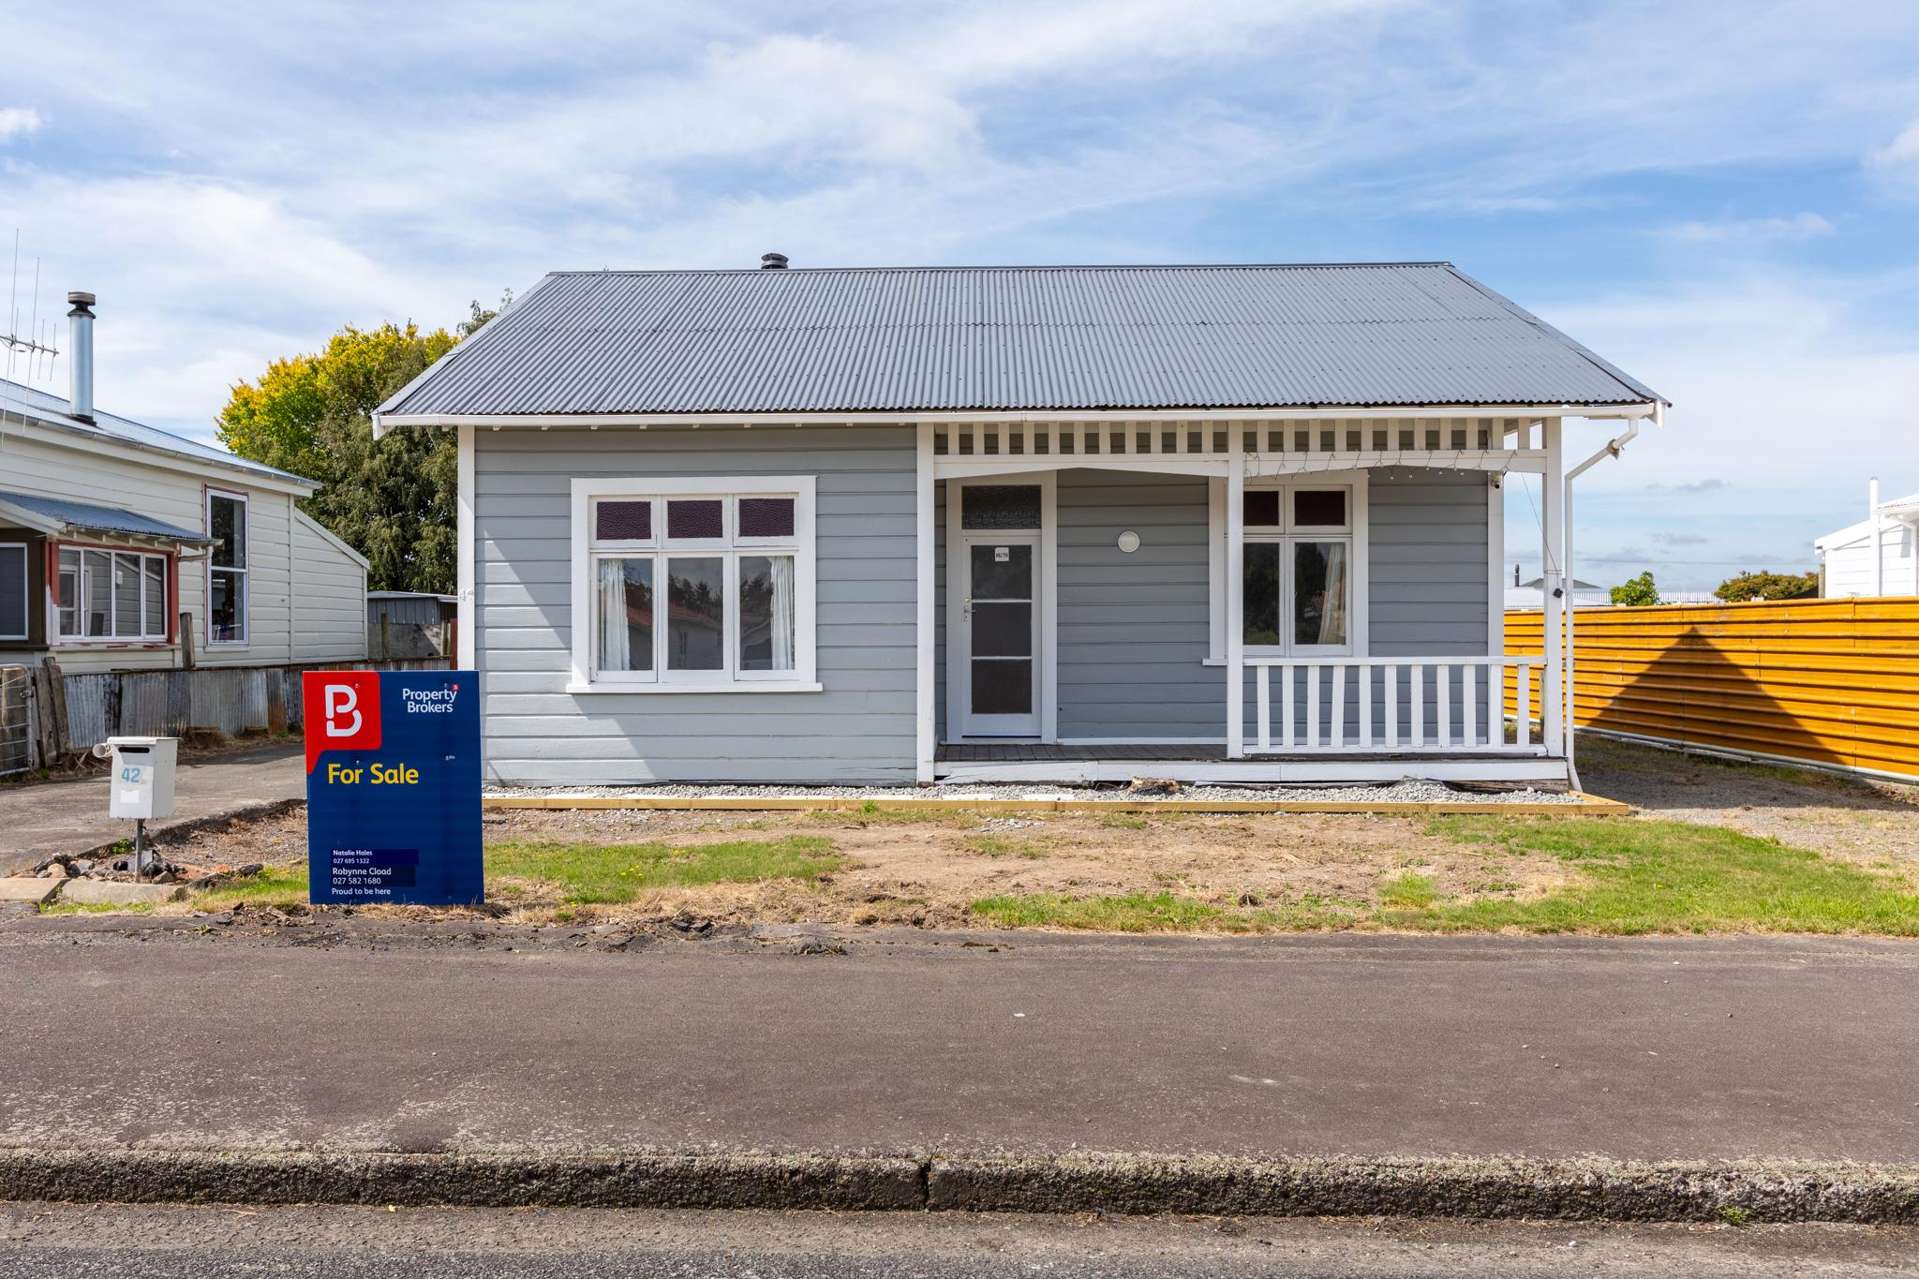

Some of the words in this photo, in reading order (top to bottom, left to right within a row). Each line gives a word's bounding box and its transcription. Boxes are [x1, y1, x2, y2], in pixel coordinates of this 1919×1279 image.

[402, 688, 457, 703] Property
[407, 700, 454, 713] Brokers
[121, 767, 141, 783] 42
[328, 762, 364, 784] For
[370, 762, 419, 784] Sale
[332, 867, 367, 877] Robynne
[332, 877, 347, 885] 027
[348, 877, 362, 885] 582
[363, 877, 382, 885] 1680
[331, 887, 353, 895] Proud
[354, 887, 363, 895] to
[363, 887, 374, 895] be
[374, 887, 392, 895] here
